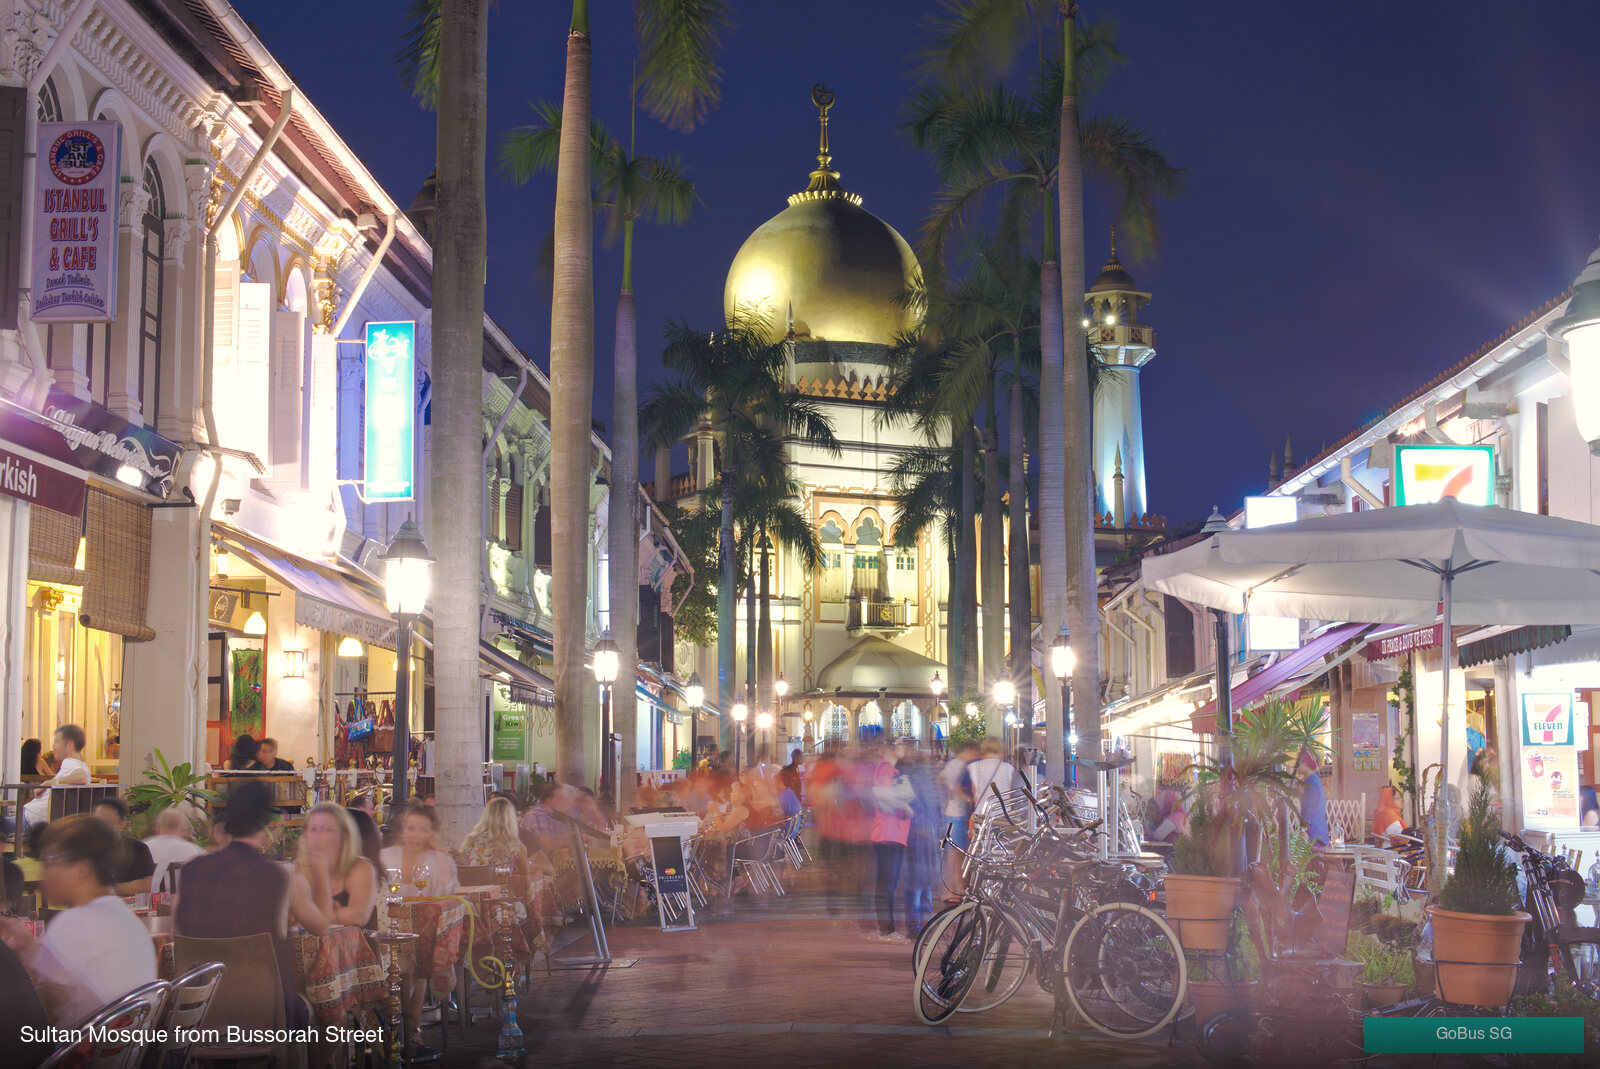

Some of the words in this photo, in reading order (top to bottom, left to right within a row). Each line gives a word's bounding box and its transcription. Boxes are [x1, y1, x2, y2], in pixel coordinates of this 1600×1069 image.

[69, 143, 89, 152] IST
[63, 160, 90, 168] BUL
[68, 152, 87, 160] AN
[43, 188, 107, 212] ISTANBUL
[49, 217, 99, 241] GRILL'S
[49, 246, 59, 270] &
[63, 246, 97, 270] CAFE
